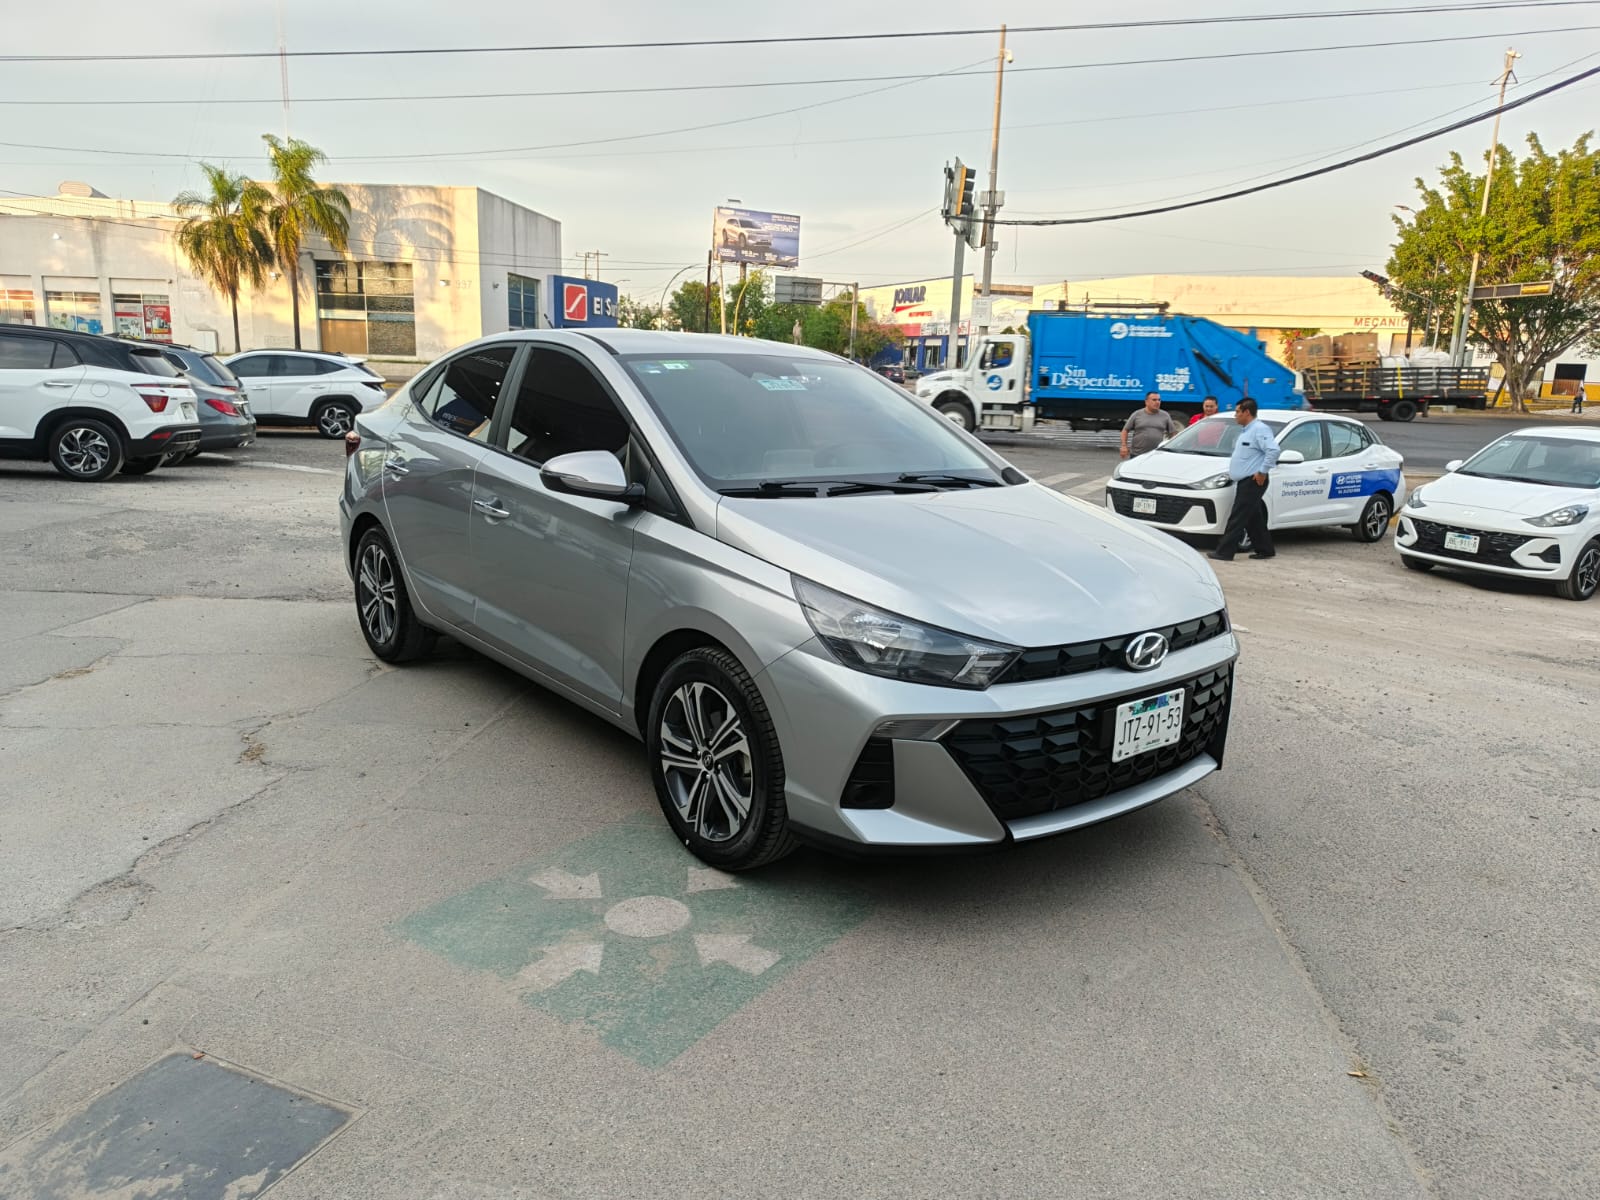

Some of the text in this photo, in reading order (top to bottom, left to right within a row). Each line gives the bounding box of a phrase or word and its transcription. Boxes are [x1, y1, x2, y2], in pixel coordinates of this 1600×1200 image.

[593, 296, 603, 315] El
[1064, 364, 1086, 377] Sin
[1051, 372, 1144, 390] Desperdicio.
[1282, 479, 1304, 488] Hyundai
[1281, 488, 1324, 497] Driving Experience
[1119, 706, 1181, 746] JTZ-91-53
